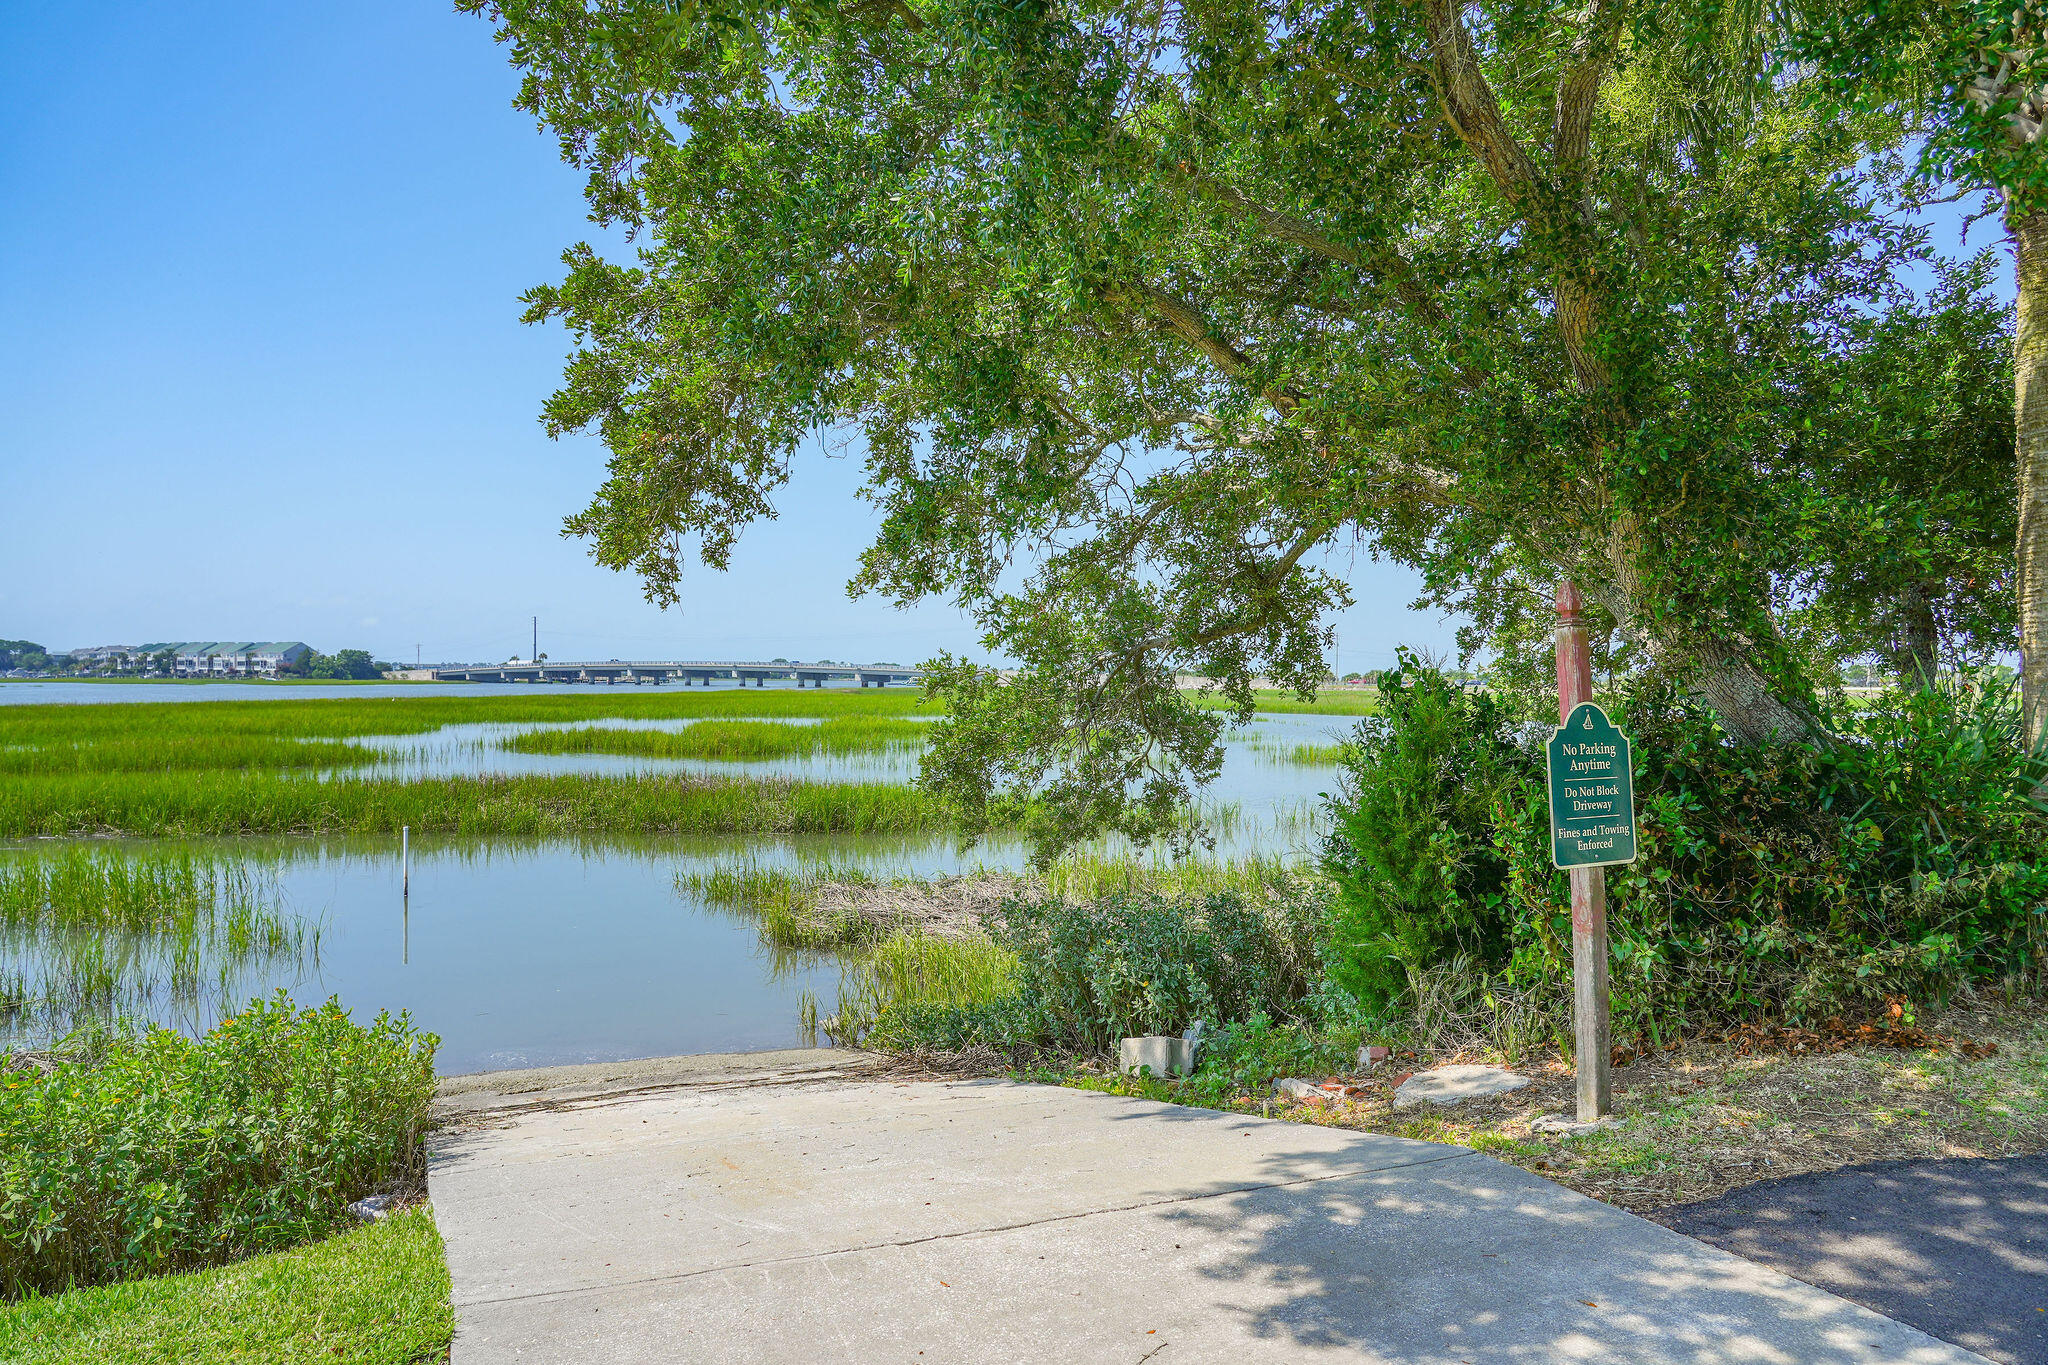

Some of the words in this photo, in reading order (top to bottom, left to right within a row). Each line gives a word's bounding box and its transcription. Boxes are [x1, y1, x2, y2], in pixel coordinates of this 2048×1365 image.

[1562, 743, 1577, 756] No
[1579, 742, 1616, 757] Parking
[1569, 758, 1611, 774] Anytime
[1564, 787, 1577, 798] Do
[1578, 786, 1595, 797] Not
[1596, 785, 1619, 796] Block
[1573, 800, 1612, 812] Driveway
[1558, 828, 1580, 839] Fines
[1582, 825, 1597, 837] and
[1599, 824, 1630, 837] Towing
[1577, 838, 1613, 851] Enforced
